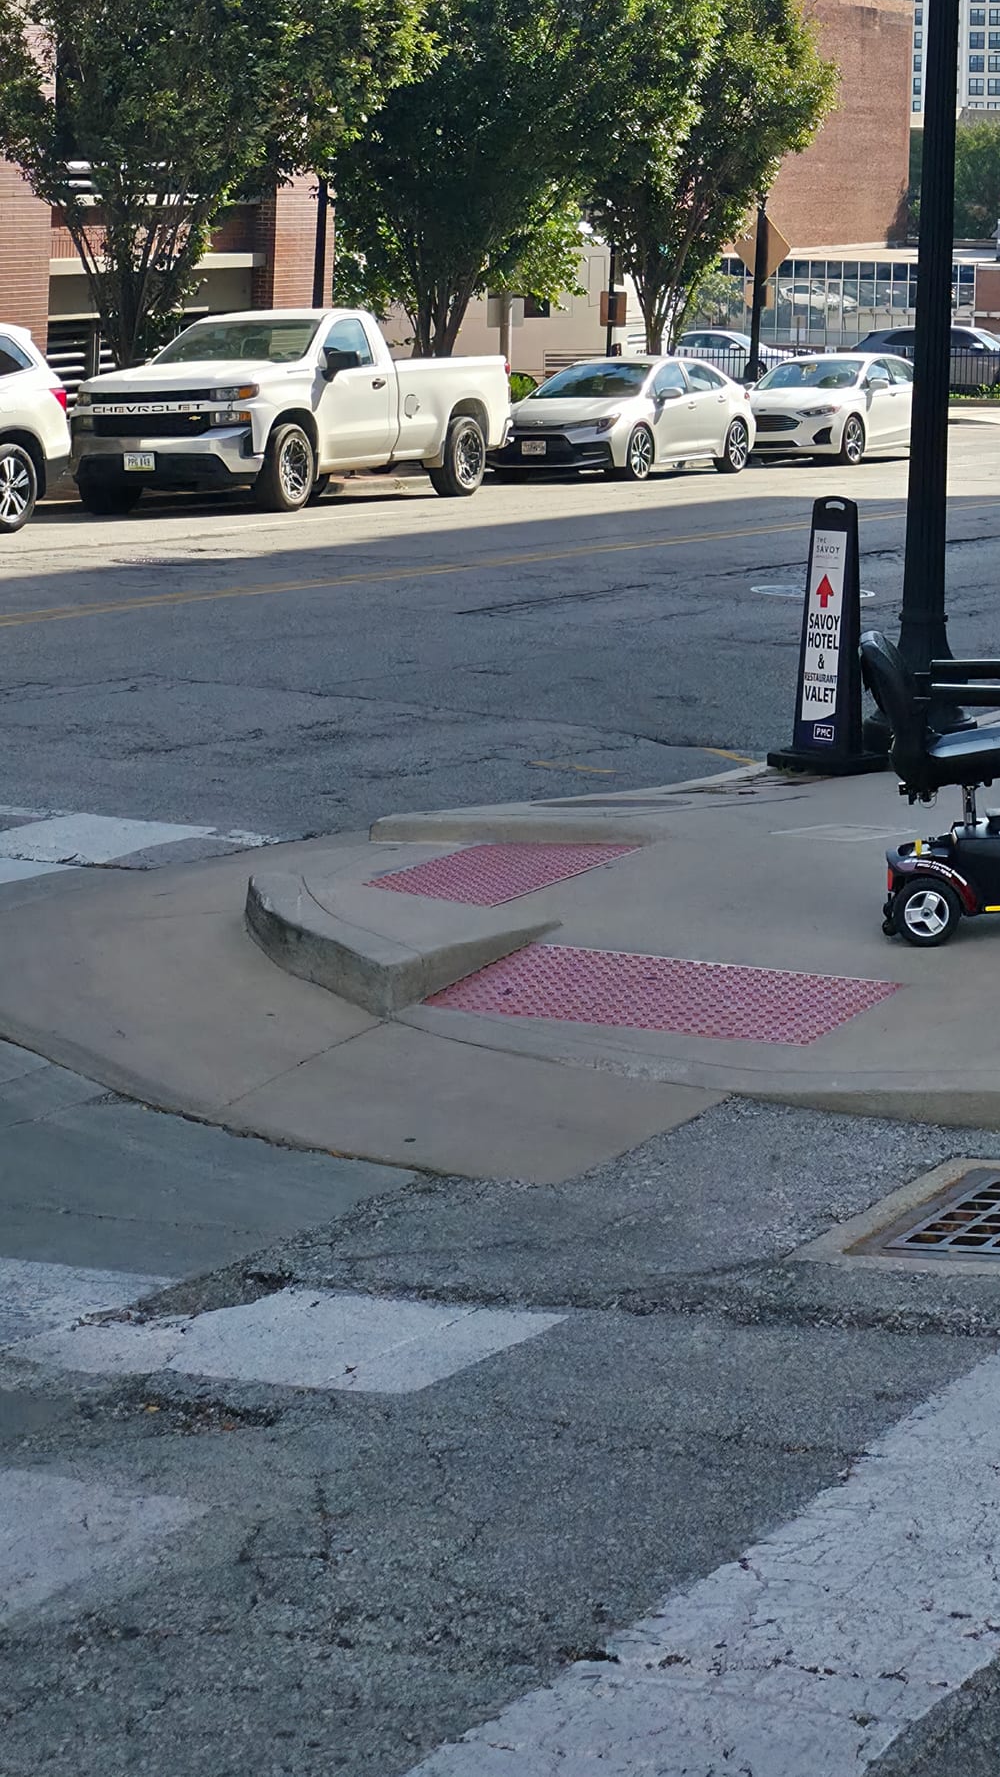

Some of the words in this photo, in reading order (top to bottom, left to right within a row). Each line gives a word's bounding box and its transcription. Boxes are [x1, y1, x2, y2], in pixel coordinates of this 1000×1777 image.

[92, 403, 204, 413] CHEVROLET
[816, 544, 840, 554] SAVOY
[809, 612, 841, 631] SAVOY
[807, 632, 839, 650] HOTEL
[817, 653, 825, 670] &
[804, 671, 838, 684] RESTAURANT
[804, 685, 836, 704] VALET
[816, 726, 832, 738] PMC
